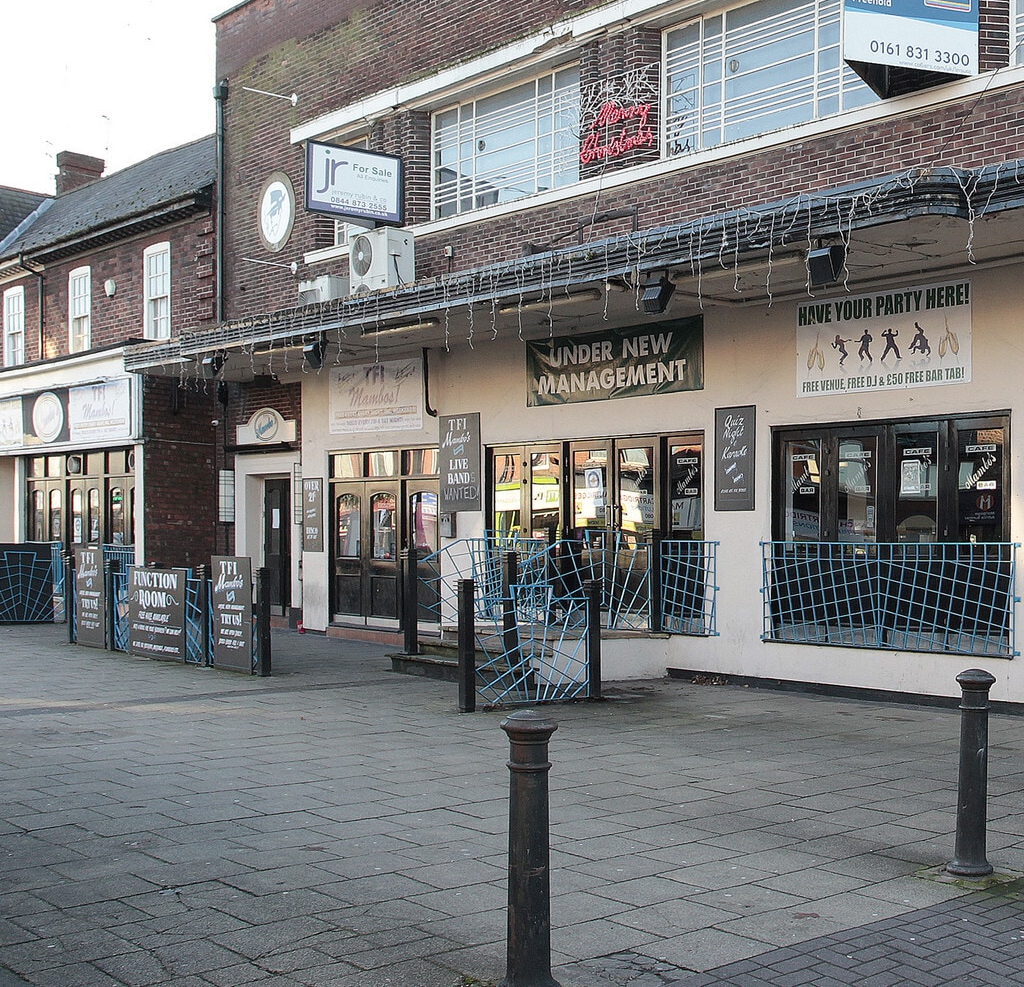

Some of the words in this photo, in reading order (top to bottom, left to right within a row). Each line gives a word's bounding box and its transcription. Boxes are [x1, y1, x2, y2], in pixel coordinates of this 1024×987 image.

[870, 40, 900, 56] 0161
[906, 45, 929, 60] 831
[934, 50, 970, 66] 3300
[316, 149, 349, 194] jr
[352, 164, 369, 174] For
[371, 166, 393, 178] Sale
[364, 174, 389, 184] Enquiries
[330, 196, 349, 205] 0844
[351, 199, 366, 208] 873
[368, 202, 387, 211] 2555
[331, 189, 353, 198] jeremy
[354, 193, 372, 201] rubin
[330, 204, 388, 217] www.jeremyrubin.co.uk
[798, 303, 832, 327] HAVE
[835, 297, 872, 322] YOUR
[876, 289, 922, 316] PARTY
[925, 282, 970, 310] HERE!
[550, 340, 614, 367] UNDER
[622, 332, 673, 359] NEW
[363, 364, 385, 386] TFI
[538, 359, 687, 395] MANAGEMENT
[802, 381, 819, 393] FREE
[820, 378, 846, 392] VENUE,
[847, 376, 865, 390] FREE
[878, 376, 885, 386] &
[886, 372, 903, 386] £50
[905, 371, 924, 384] FREE
[925, 369, 943, 382] BAR
[944, 367, 965, 379] TAB!
[448, 418, 467, 431] TFI
[724, 414, 745, 430] Quiz
[442, 431, 471, 449] Mambo's
[723, 425, 745, 444] Night
[449, 458, 469, 471] LIVE
[964, 452, 997, 490] Mambo's
[304, 481, 321, 491] OVER
[443, 485, 480, 501] WANTED!
[80, 551, 95, 565] TFI
[219, 560, 238, 575] TFI
[133, 570, 178, 590] FUNCTION
[214, 574, 244, 592] Mambo's
[138, 589, 167, 610] ROOM
[220, 613, 231, 625] TRY
[232, 612, 242, 626] US!
